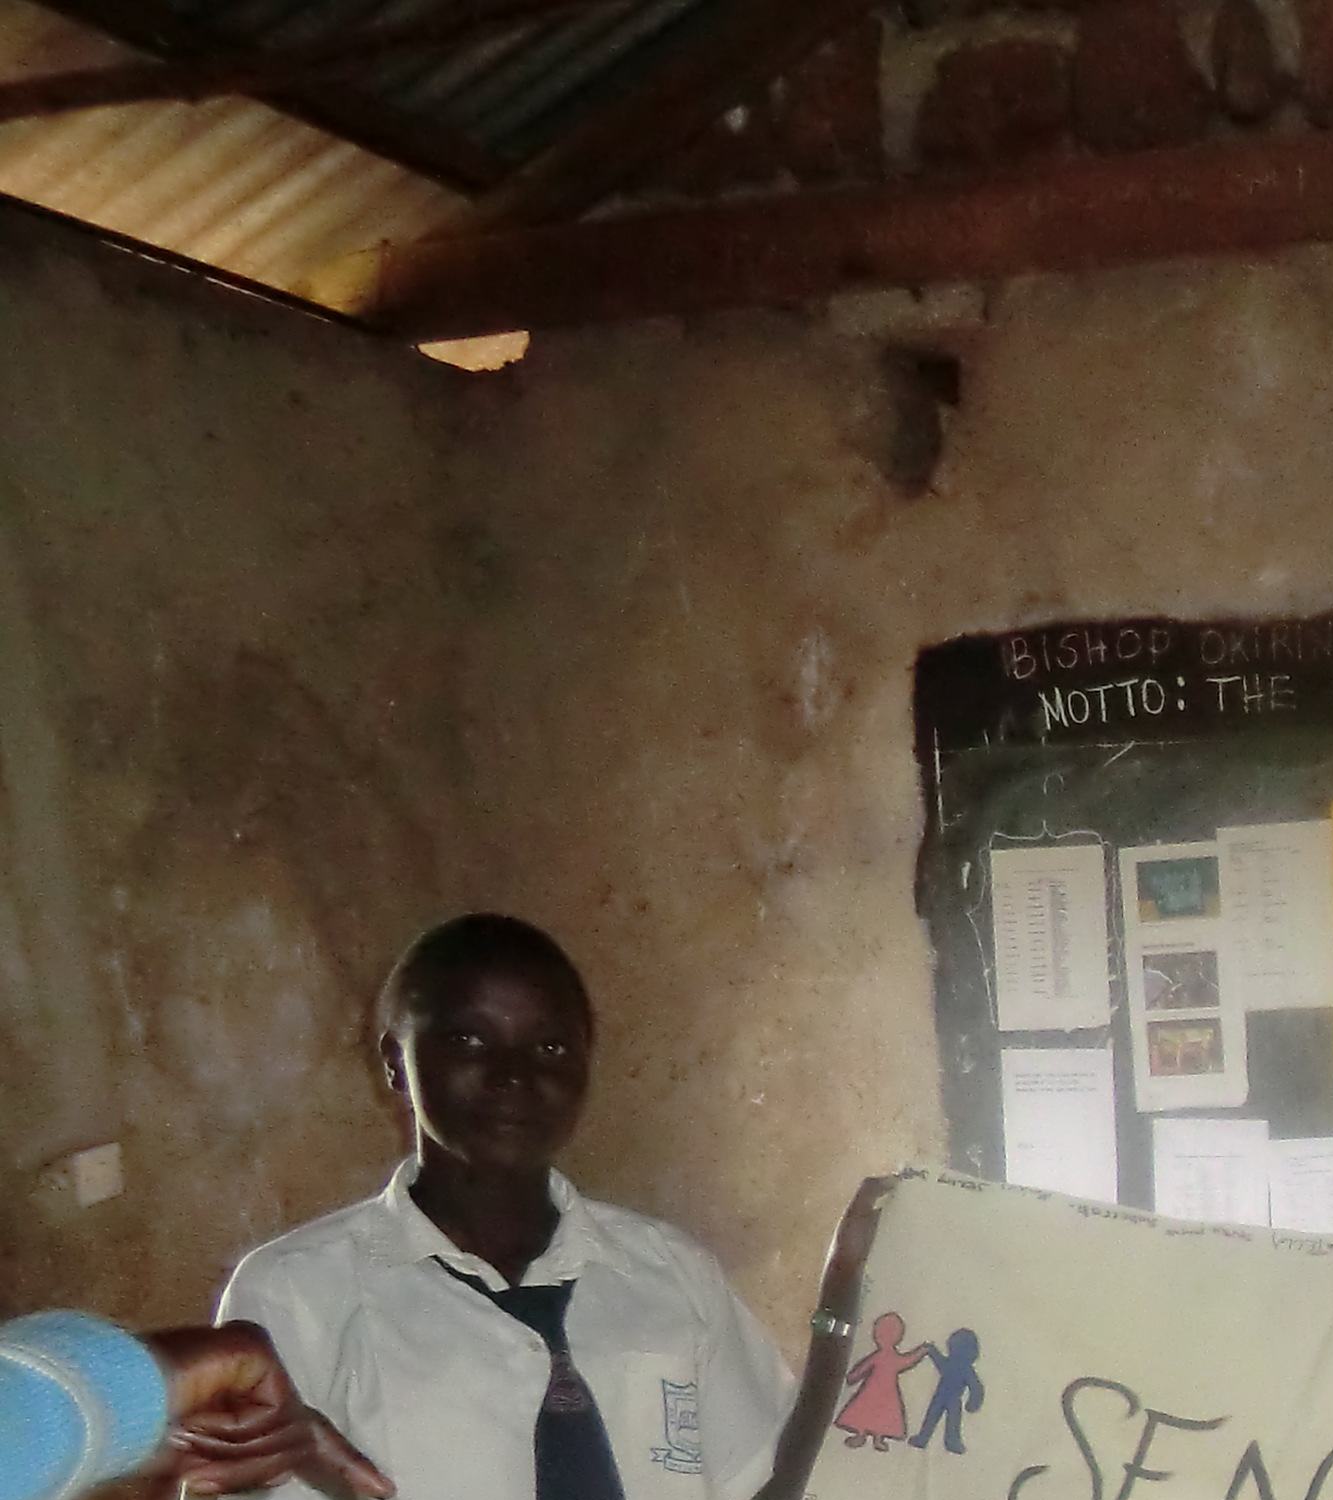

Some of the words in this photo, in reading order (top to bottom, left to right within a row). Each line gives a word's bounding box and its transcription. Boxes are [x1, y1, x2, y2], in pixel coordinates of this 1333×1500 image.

[1010, 628, 1171, 681] BISHOP
[1040, 678, 1188, 731] MOTTO:
[1206, 673, 1297, 714] THE
